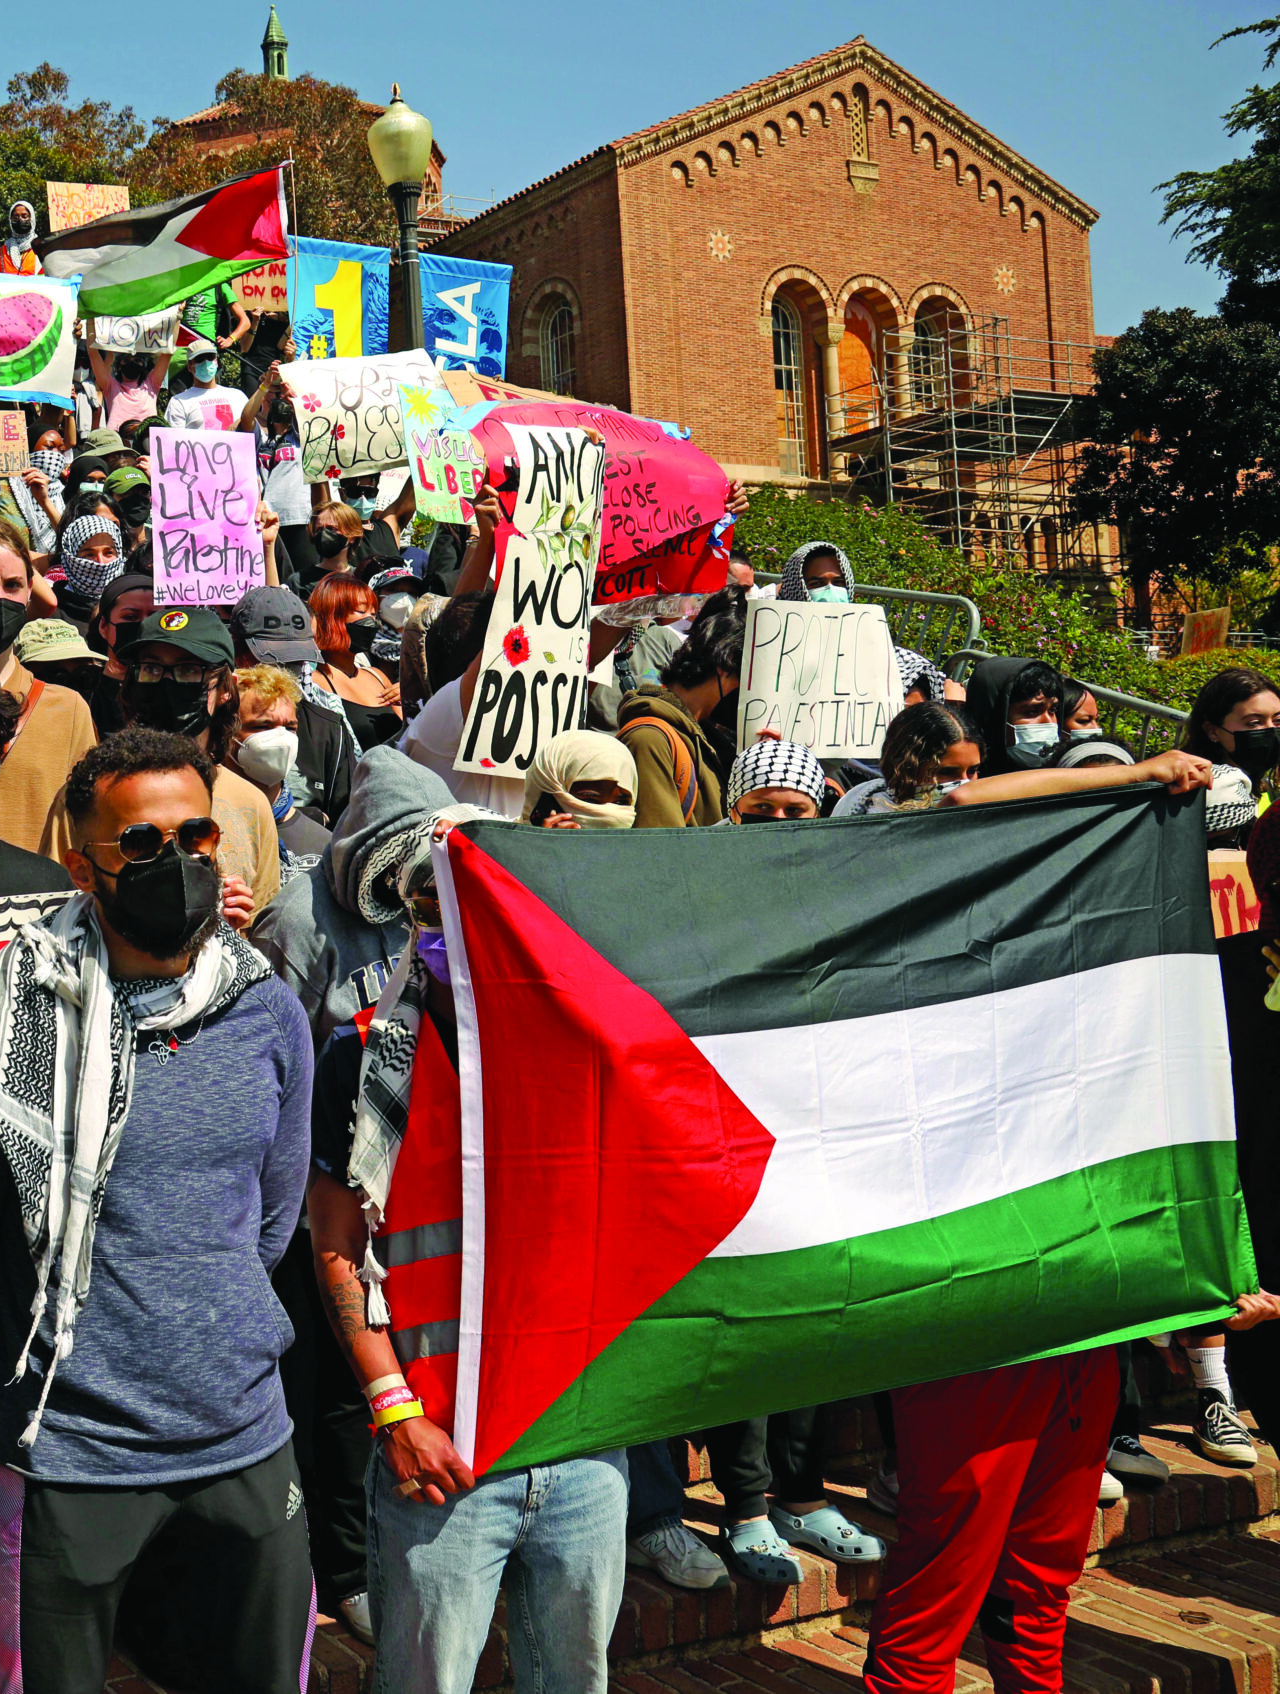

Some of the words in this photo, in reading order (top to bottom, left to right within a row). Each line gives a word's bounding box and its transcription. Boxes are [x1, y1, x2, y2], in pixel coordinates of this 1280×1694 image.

[155, 435, 236, 494] Long
[158, 474, 249, 527] Live
[609, 504, 703, 539] POLICING
[263, 614, 306, 631] D-9
[746, 607, 892, 697] PROTECT
